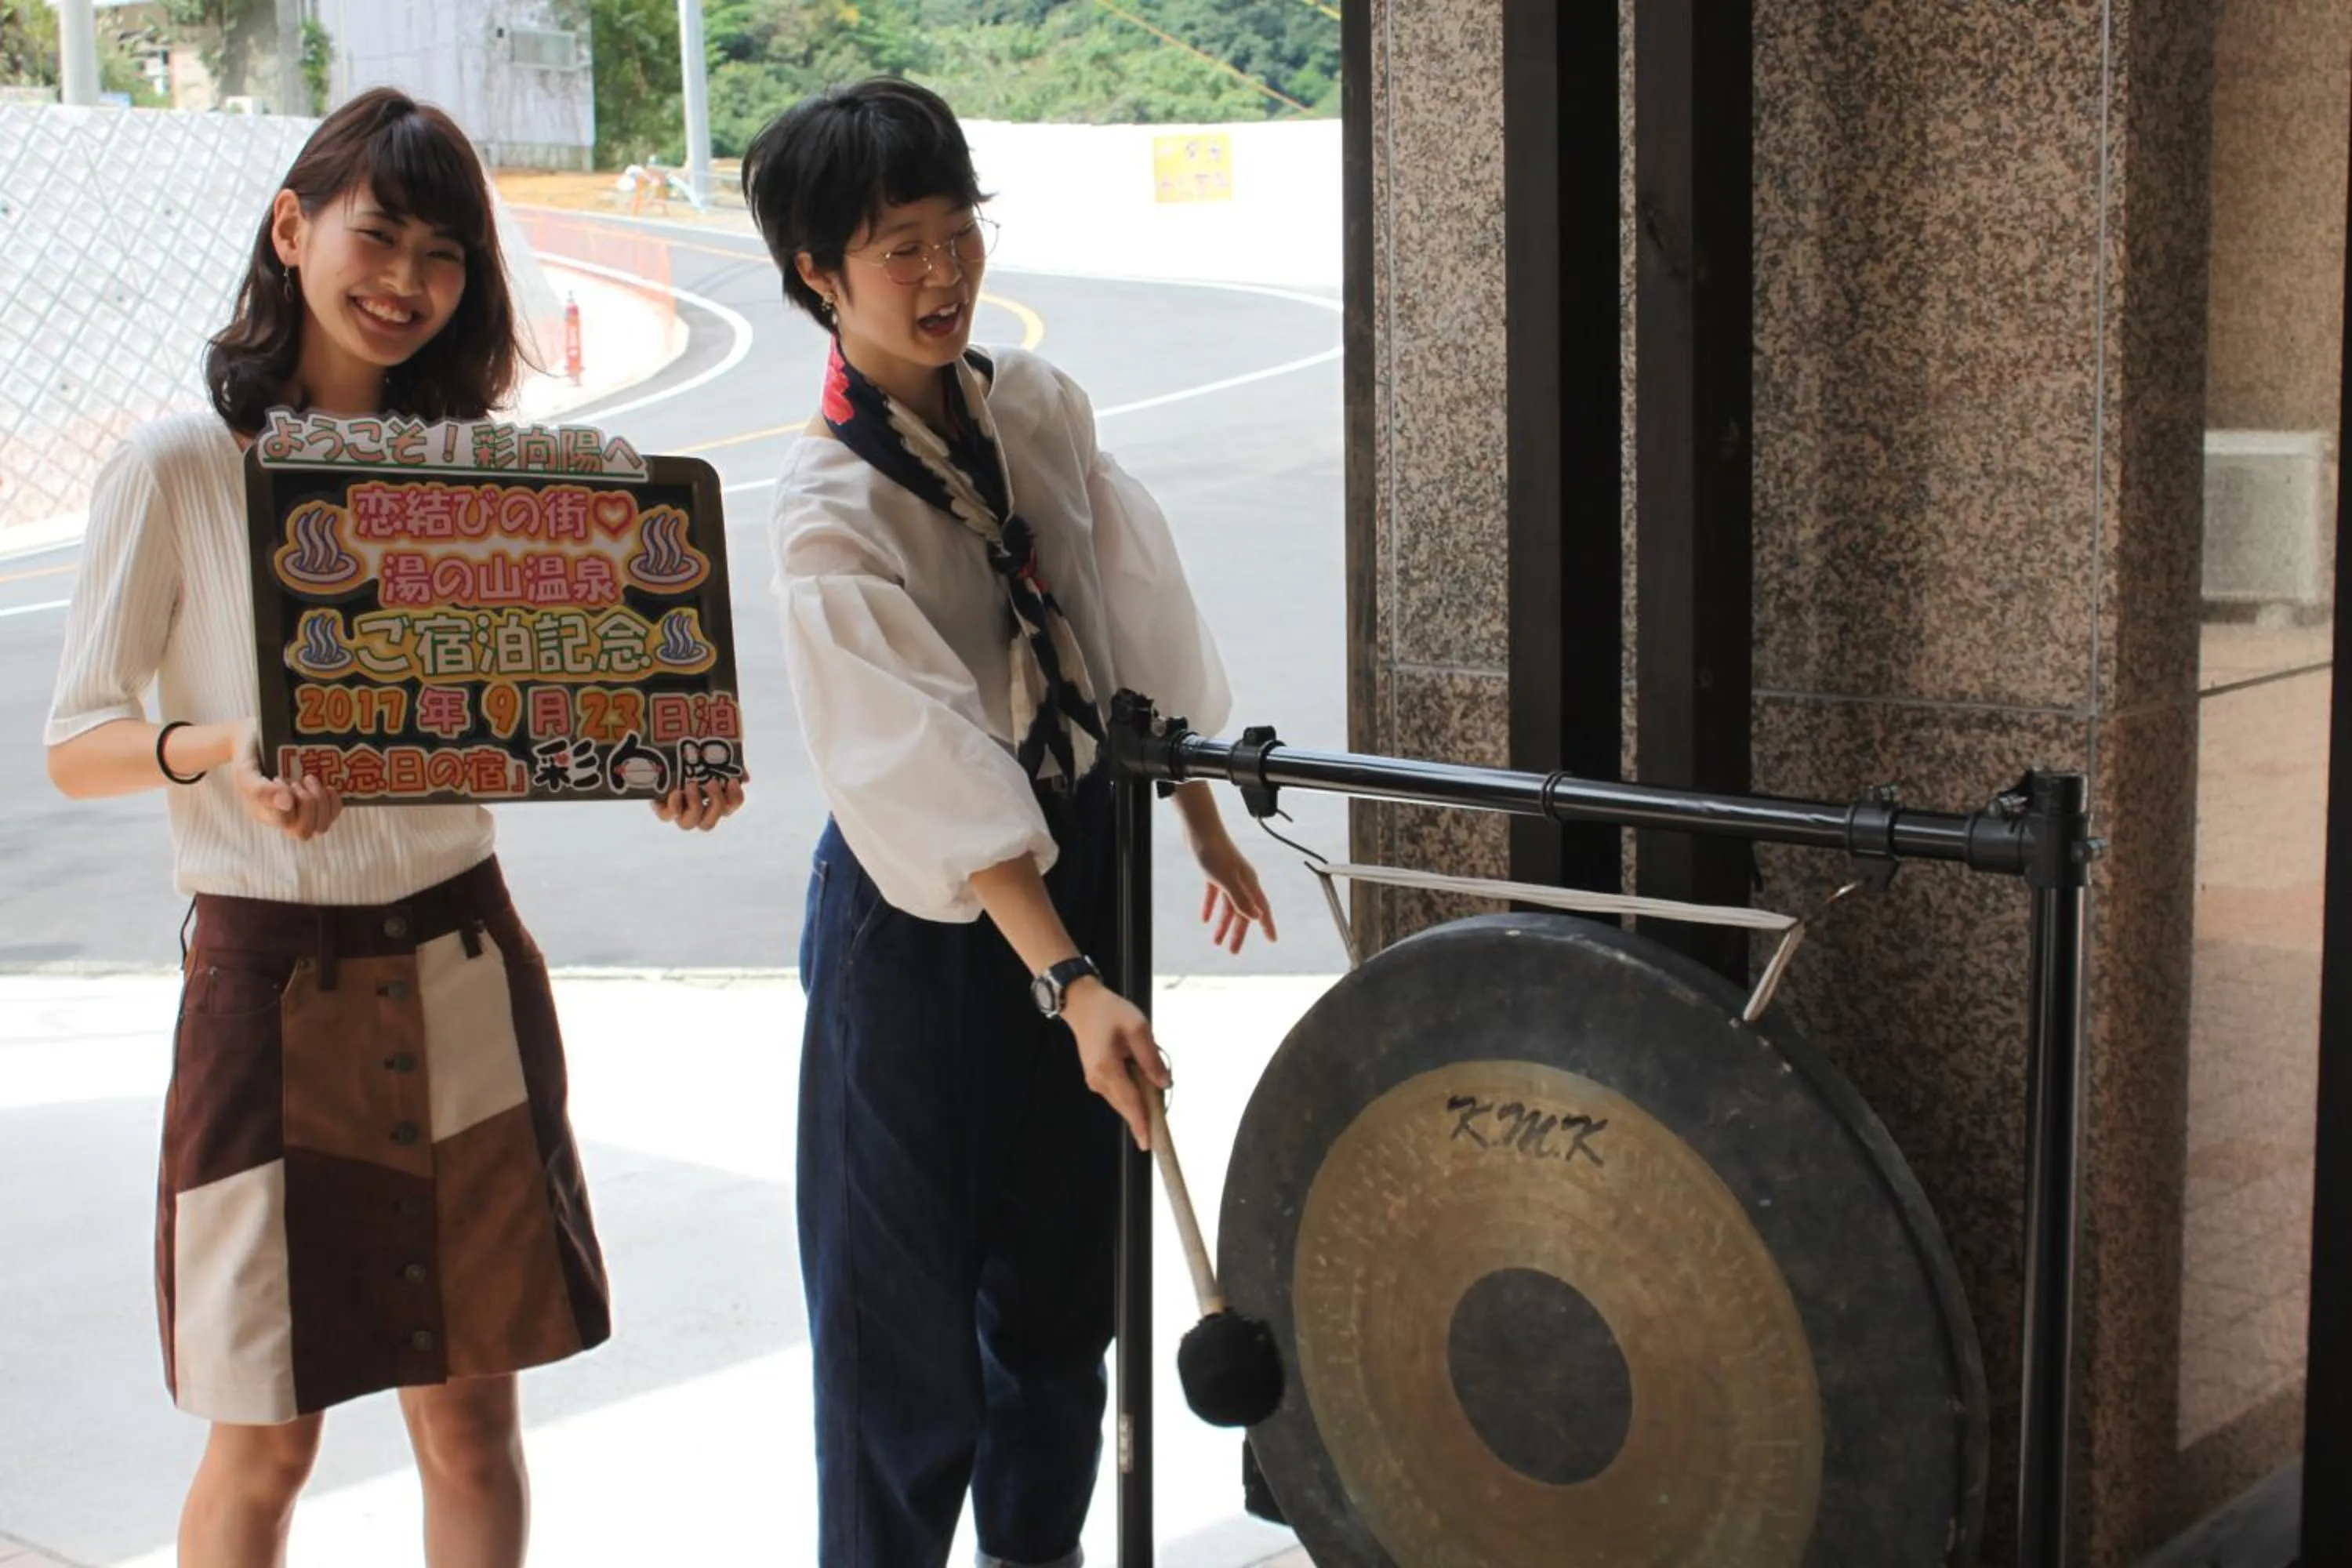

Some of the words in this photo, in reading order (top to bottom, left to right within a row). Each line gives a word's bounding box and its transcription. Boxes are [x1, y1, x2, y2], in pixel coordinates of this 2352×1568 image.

[383, 552, 617, 604] 湯の山温泉
[357, 612, 652, 676] ご宿泊記念
